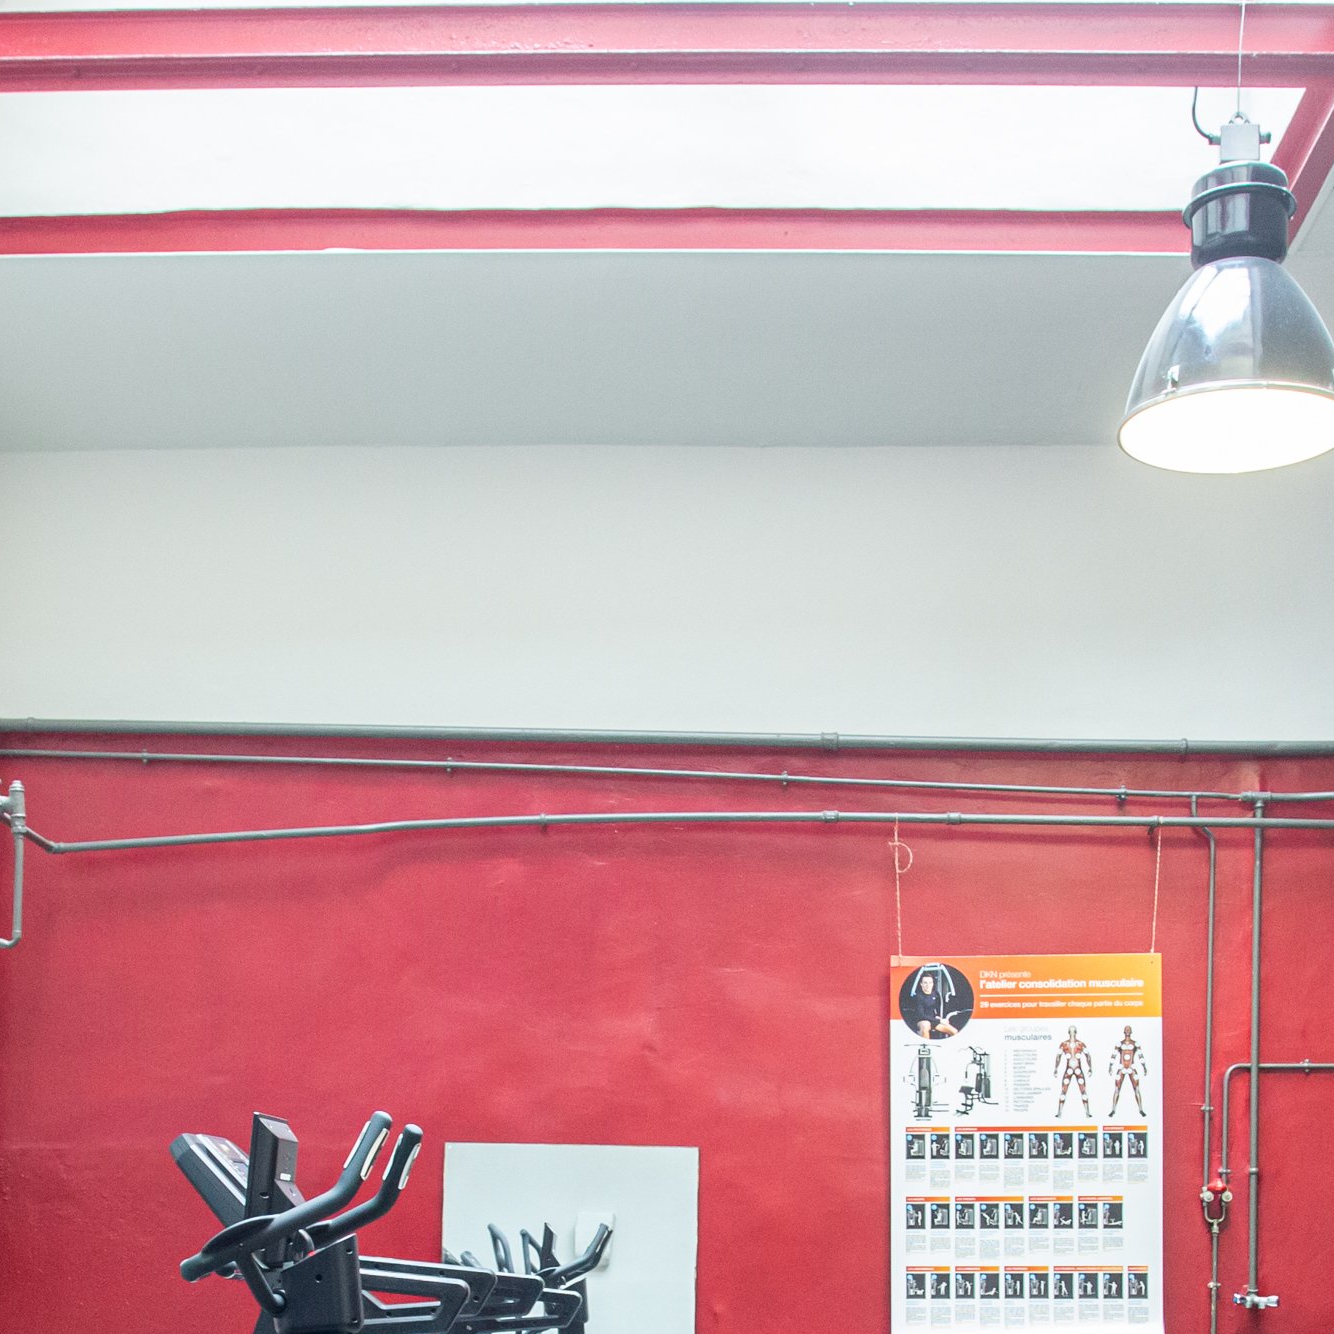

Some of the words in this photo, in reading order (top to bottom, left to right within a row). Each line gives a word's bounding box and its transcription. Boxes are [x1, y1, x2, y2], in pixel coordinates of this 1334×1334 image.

[979, 979, 1017, 990] l'atelier
[1019, 979, 1087, 989] consolidation
[1089, 978, 1145, 988] musculaire
